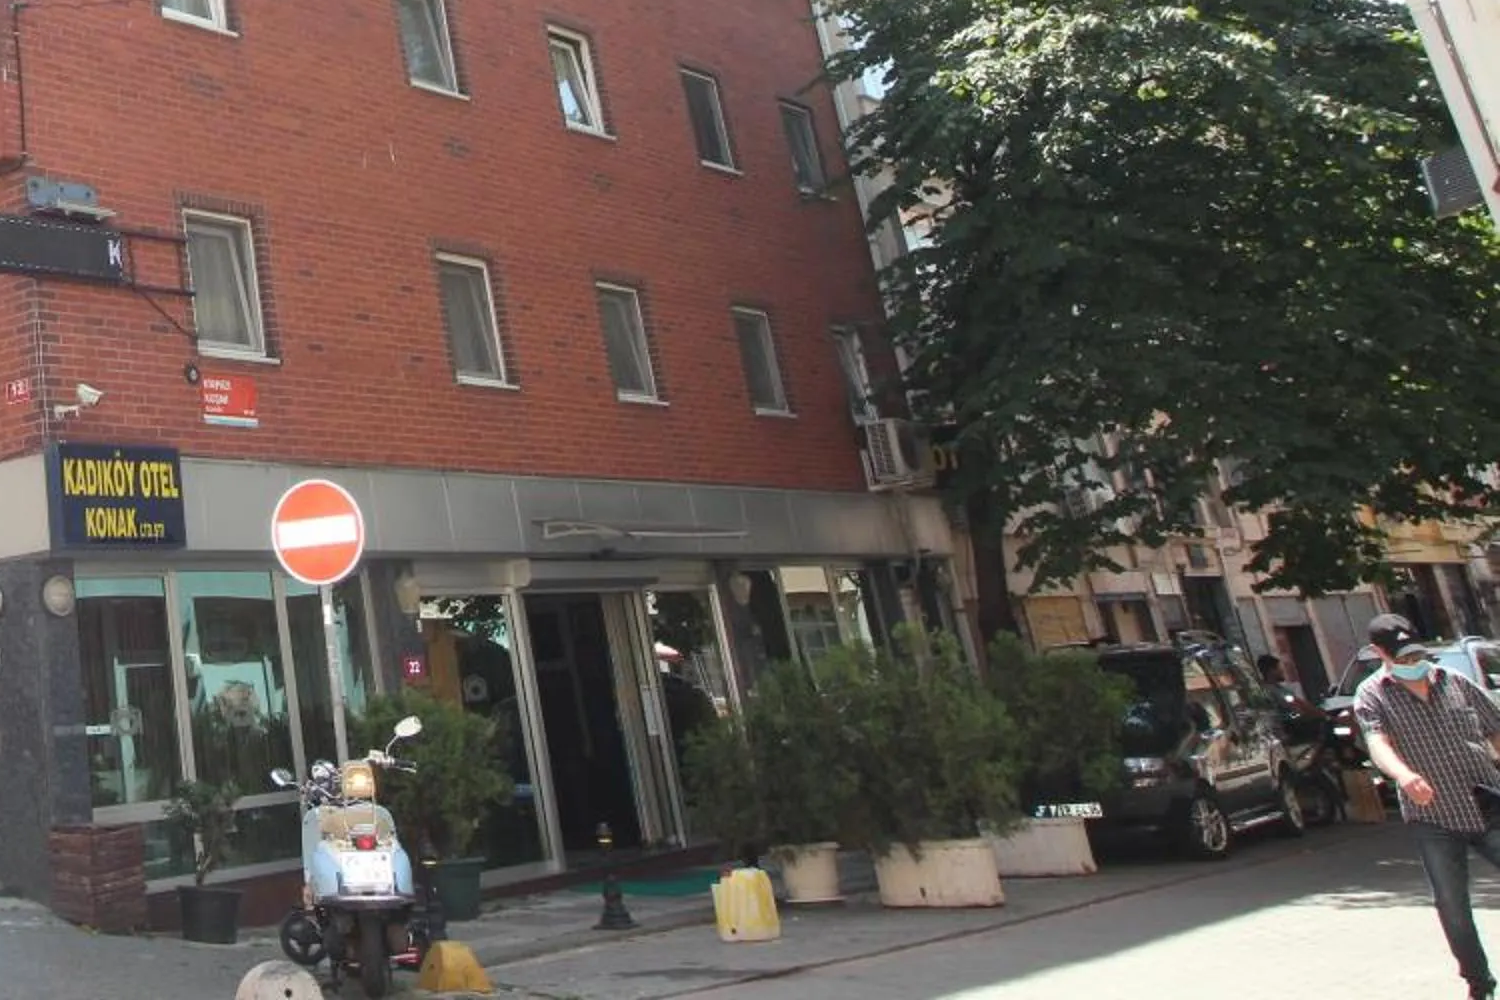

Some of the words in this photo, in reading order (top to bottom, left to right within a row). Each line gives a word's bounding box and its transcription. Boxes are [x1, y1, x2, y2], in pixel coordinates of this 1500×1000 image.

[63, 450, 135, 497] KADIKÖY
[140, 460, 179, 498] OTEL
[85, 507, 137, 538] KONAK
